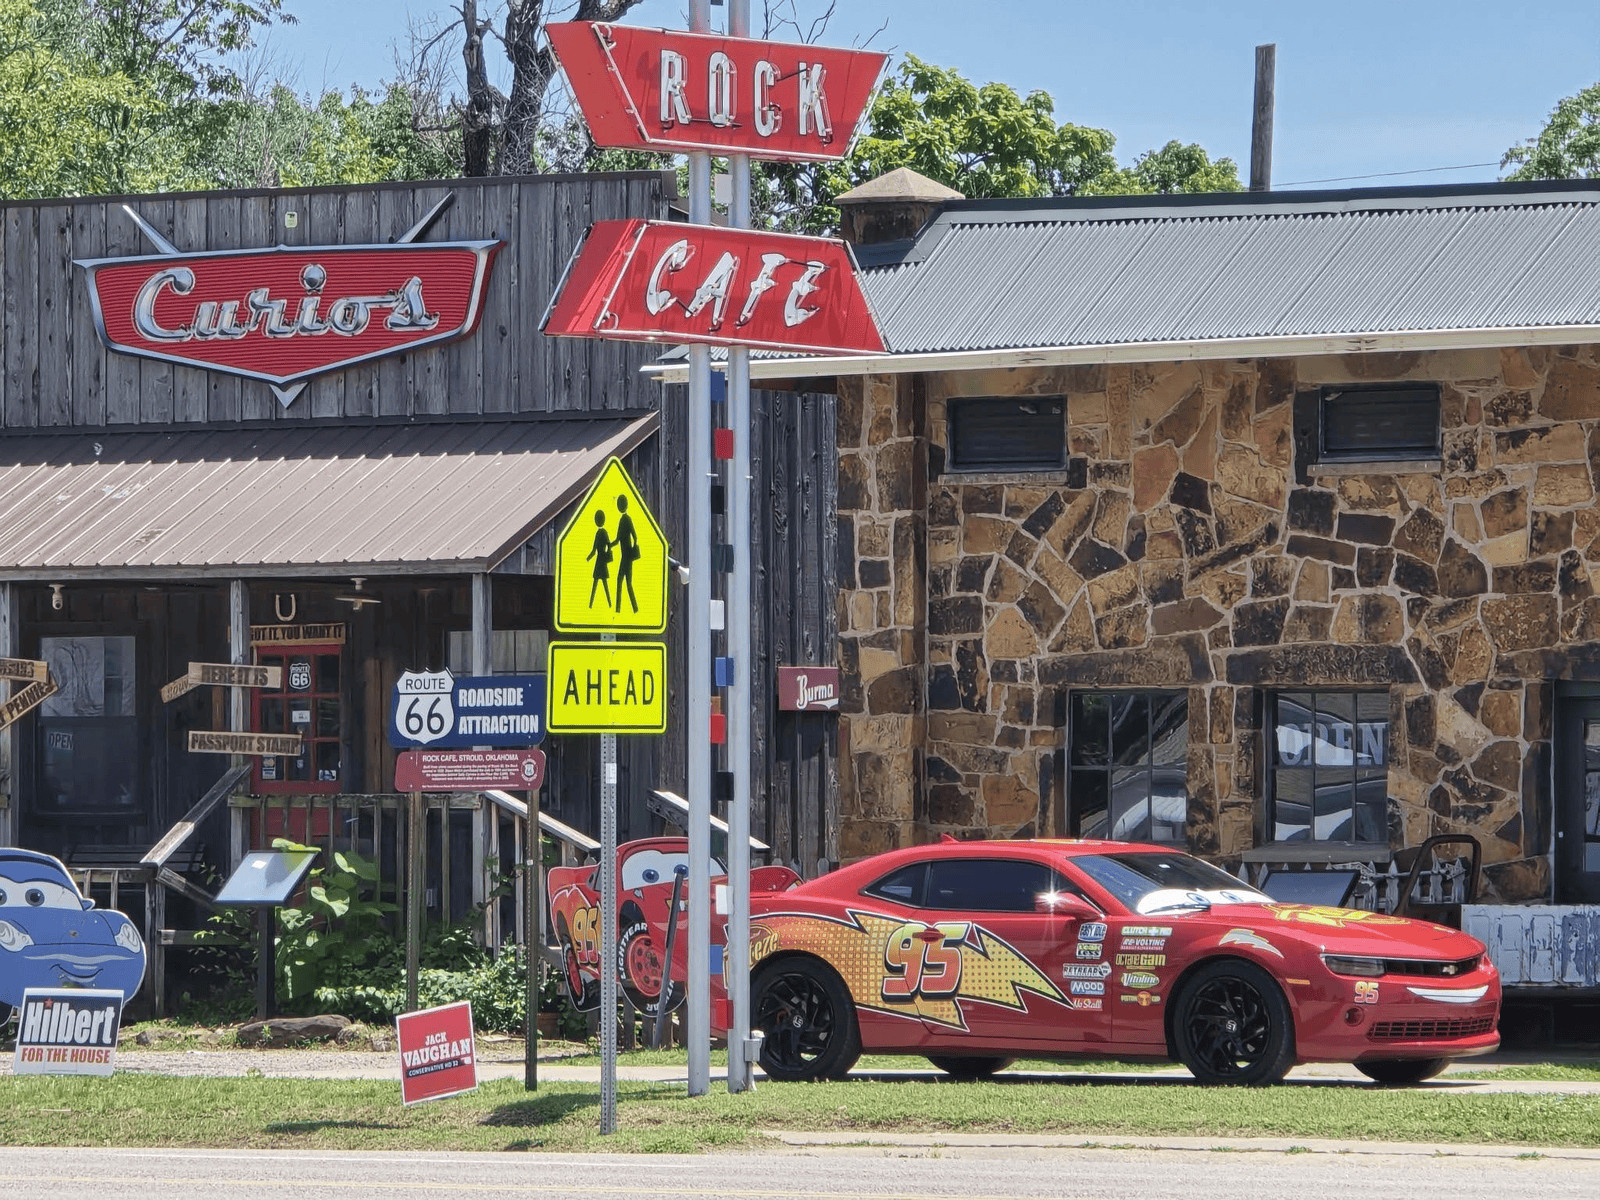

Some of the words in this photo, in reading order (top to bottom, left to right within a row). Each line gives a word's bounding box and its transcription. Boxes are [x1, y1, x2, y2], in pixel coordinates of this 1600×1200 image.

[660, 49, 830, 138] ROCK
[646, 238, 827, 328] CAFE
[131, 263, 440, 342] Curios
[281, 626, 300, 640] YOU
[302, 626, 332, 639] WANT
[333, 625, 343, 638] IT
[292, 673, 309, 686] 66
[405, 678, 446, 690] ROUTE
[563, 669, 655, 705] AHEAD
[458, 687, 524, 707] ROADSIDE
[796, 674, 834, 710] Burma
[405, 696, 445, 735] 66
[458, 714, 539, 735] ATTRACTION
[49, 732, 73, 750] OPEN
[191, 734, 255, 752] PASSPORT
[256, 736, 300, 754] STAMP
[1279, 722, 1386, 766] OPEN
[422, 754, 440, 762] ROCK
[440, 754, 458, 763] CAFE,
[458, 754, 484, 763] STROUD,
[485, 753, 519, 762] OKLAHOMA
[573, 907, 599, 965] 95
[881, 921, 972, 1003] 95
[1063, 966, 1099, 975] RETREAD
[1071, 981, 1104, 993] MOOD
[1354, 981, 1379, 1004] 95
[22, 1000, 115, 1044] Hilbert
[425, 1031, 447, 1046] JACK
[21, 1047, 44, 1062] FOR
[47, 1048, 68, 1063] THE
[70, 1048, 111, 1064] HOUSE
[402, 1038, 471, 1068] VAUGHAN
[408, 1063, 444, 1077] CONSERVATIVE
